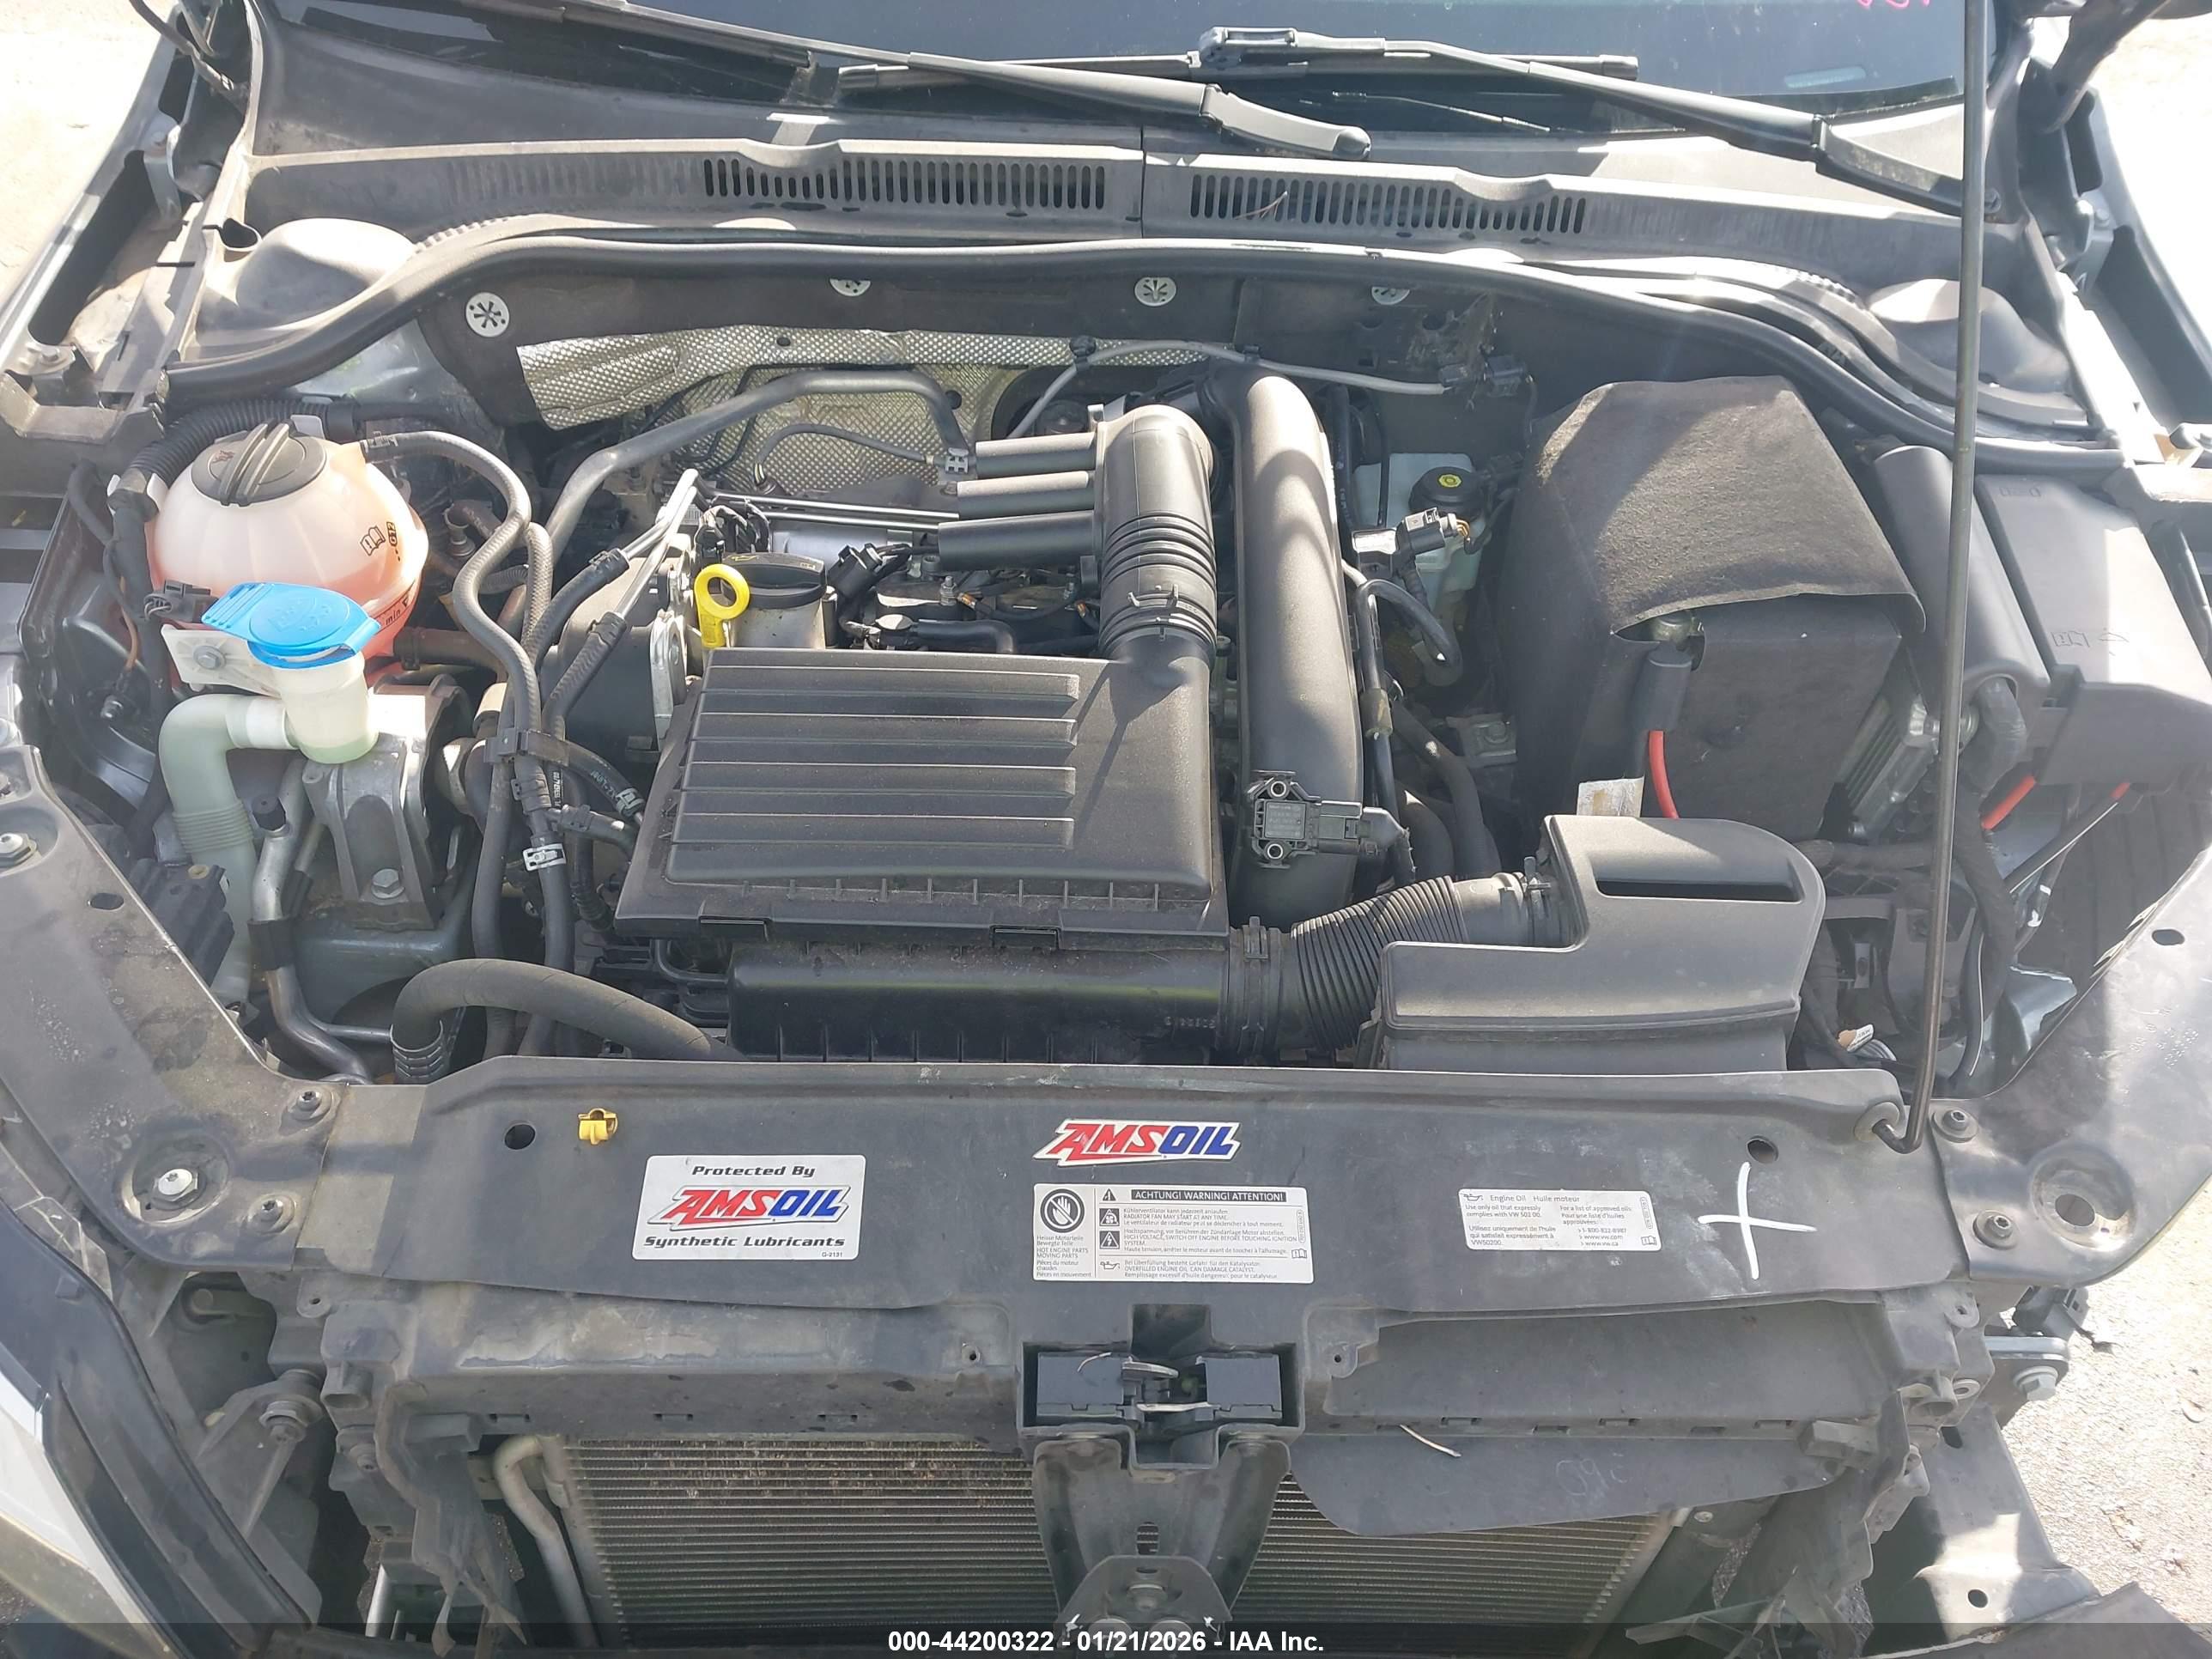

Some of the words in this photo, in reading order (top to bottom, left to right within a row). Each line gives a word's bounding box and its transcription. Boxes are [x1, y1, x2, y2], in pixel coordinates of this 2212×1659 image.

[386, 610, 401, 625] min
[1042, 1122, 1234, 1162] AMSOIL
[692, 1165, 786, 1176] Protected
[792, 1165, 815, 1178] By
[1135, 1191, 1182, 1200] ACHTUNG!
[1184, 1191, 1230, 1200] WARNING!
[1232, 1192, 1283, 1201] ATTENTION!
[659, 1188, 843, 1225] AMSOIL
[644, 1236, 736, 1249] Synthetic
[744, 1236, 845, 1247] Lubricants
